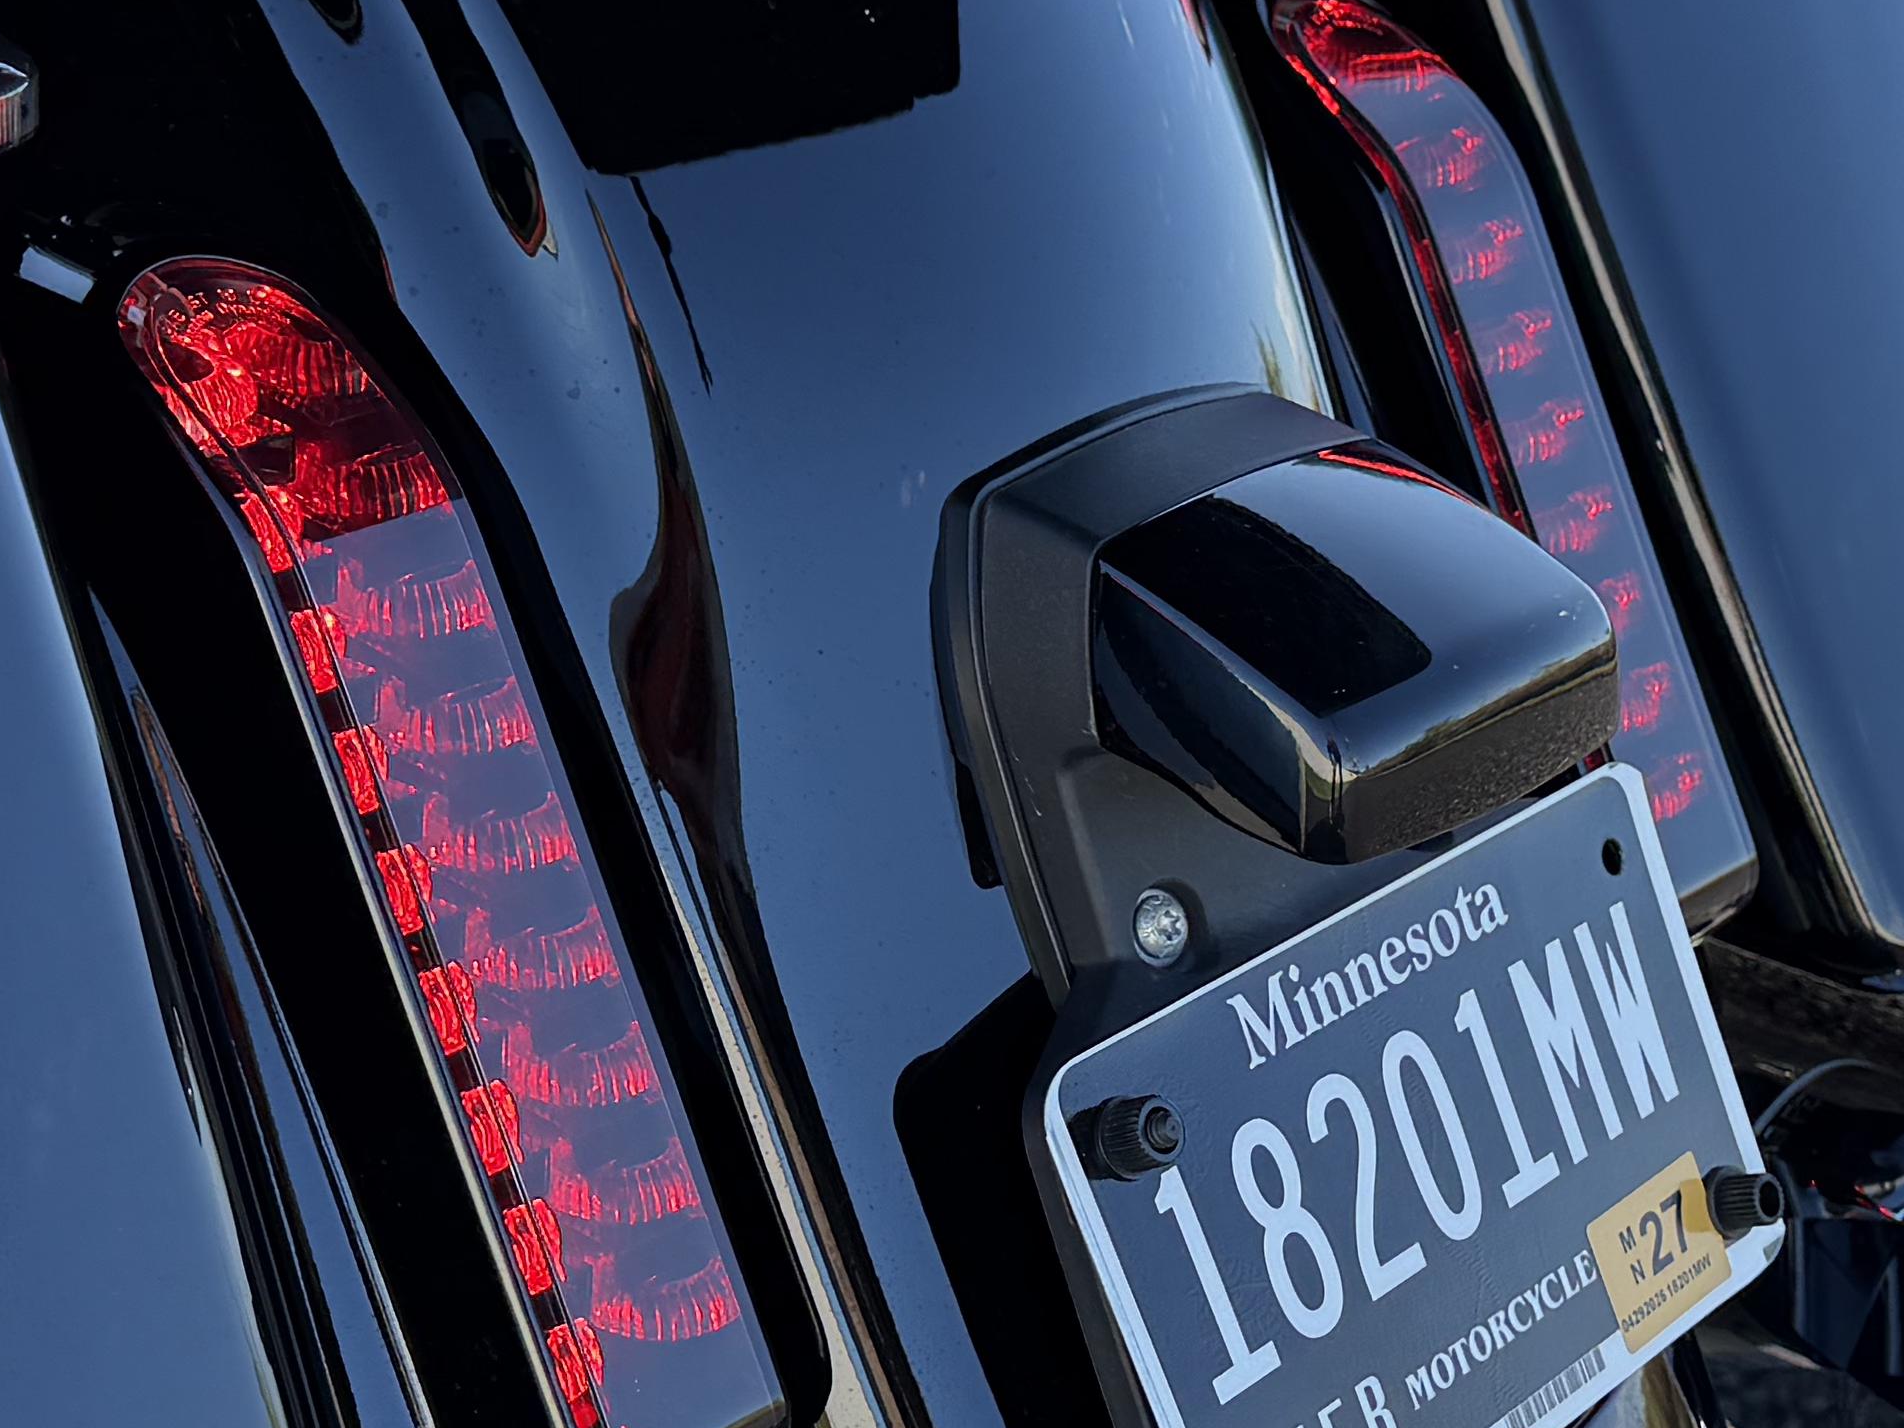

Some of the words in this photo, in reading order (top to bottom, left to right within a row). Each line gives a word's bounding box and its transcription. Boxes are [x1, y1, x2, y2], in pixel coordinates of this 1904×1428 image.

[1226, 882, 1510, 1070] Minnesota
[1155, 901, 1680, 1405] 18201MW
[1639, 1188, 1688, 1277] 27
[1405, 1249, 1598, 1411] MOTORCYCLE
